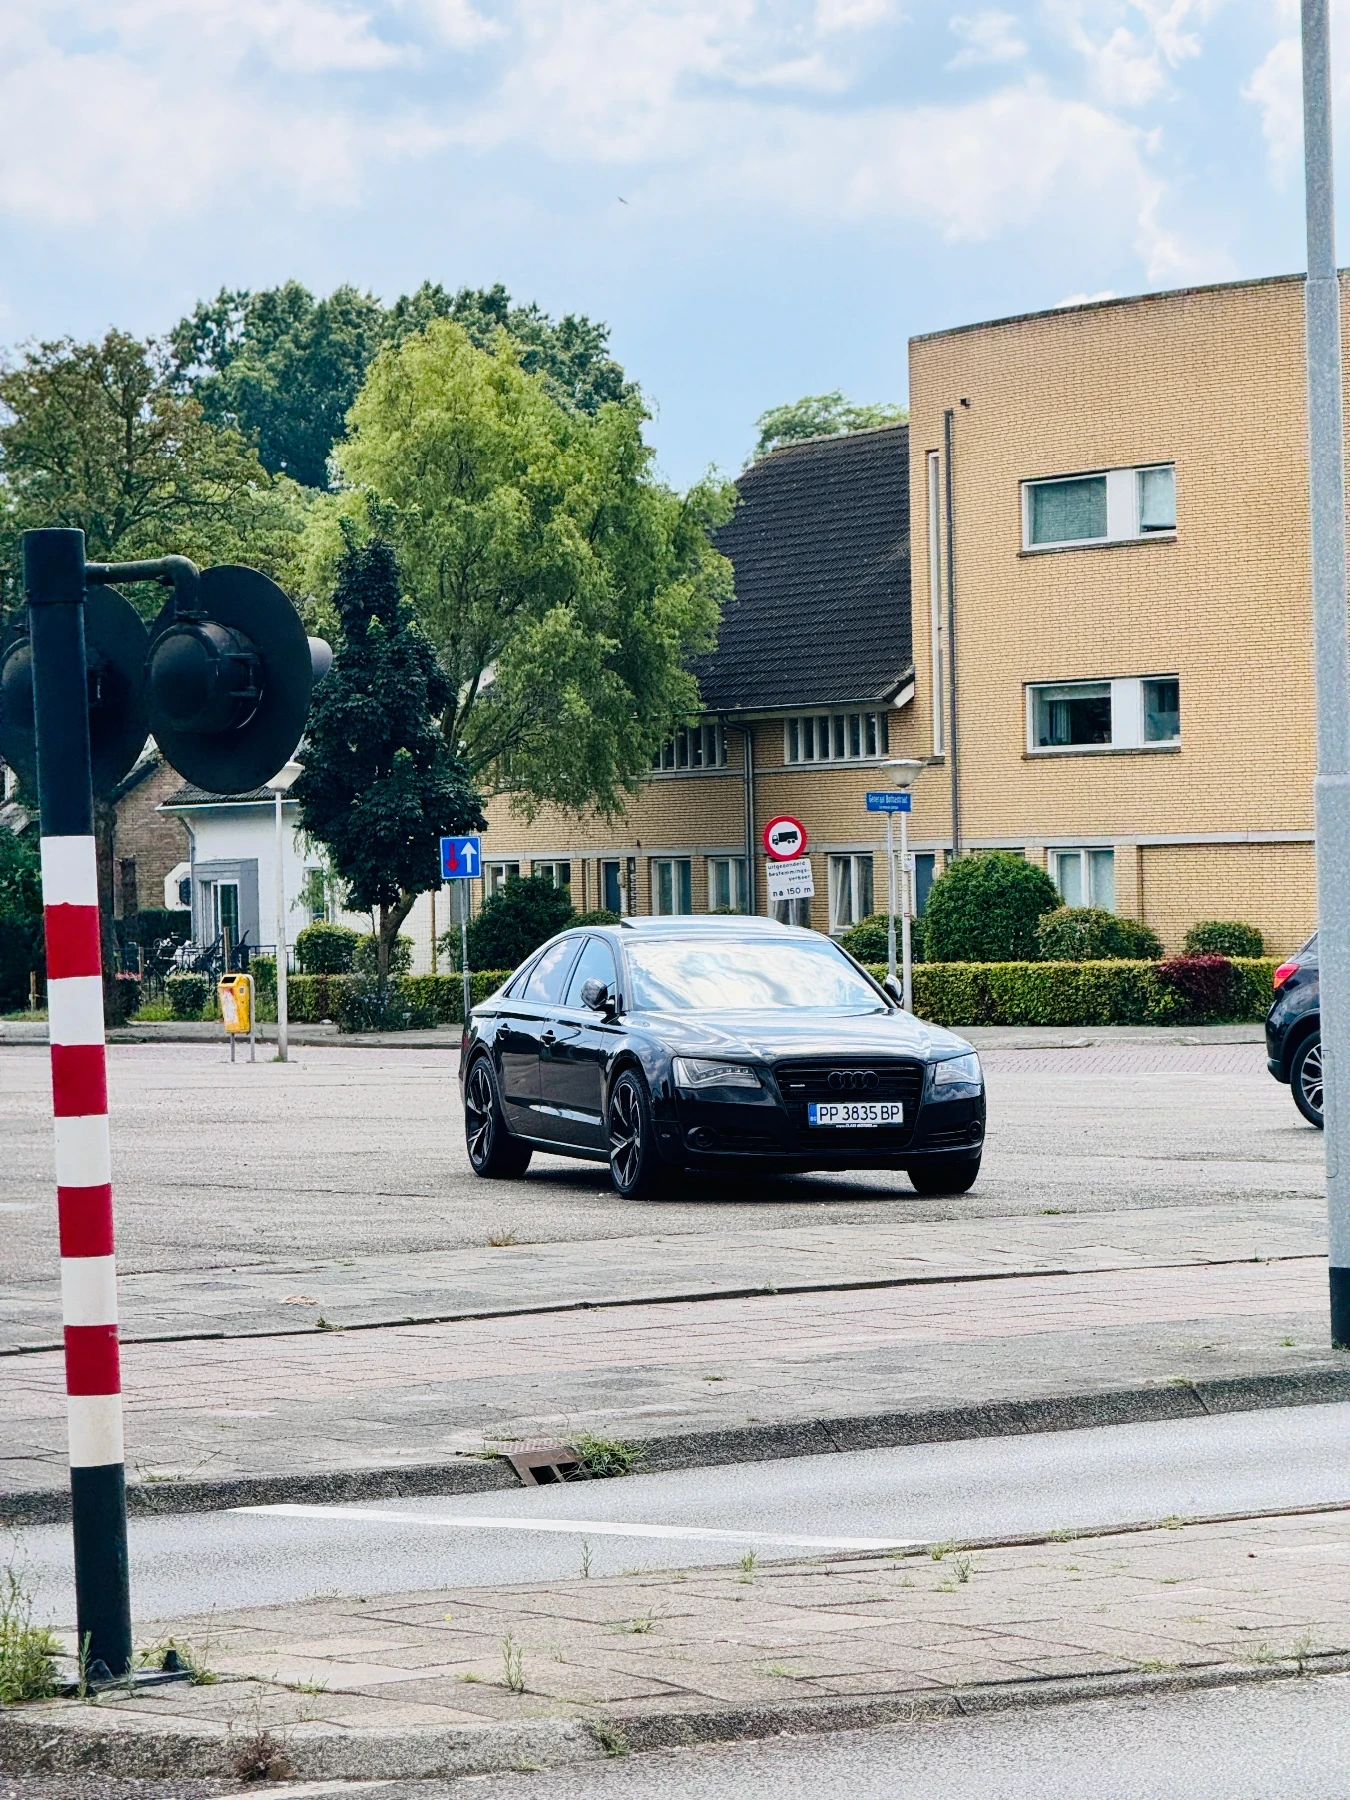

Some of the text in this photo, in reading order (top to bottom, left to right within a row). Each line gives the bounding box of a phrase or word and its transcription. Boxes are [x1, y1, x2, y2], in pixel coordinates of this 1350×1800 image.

[786, 887, 801, 895] 150
[819, 1105, 900, 1121] PP 3835 BP
